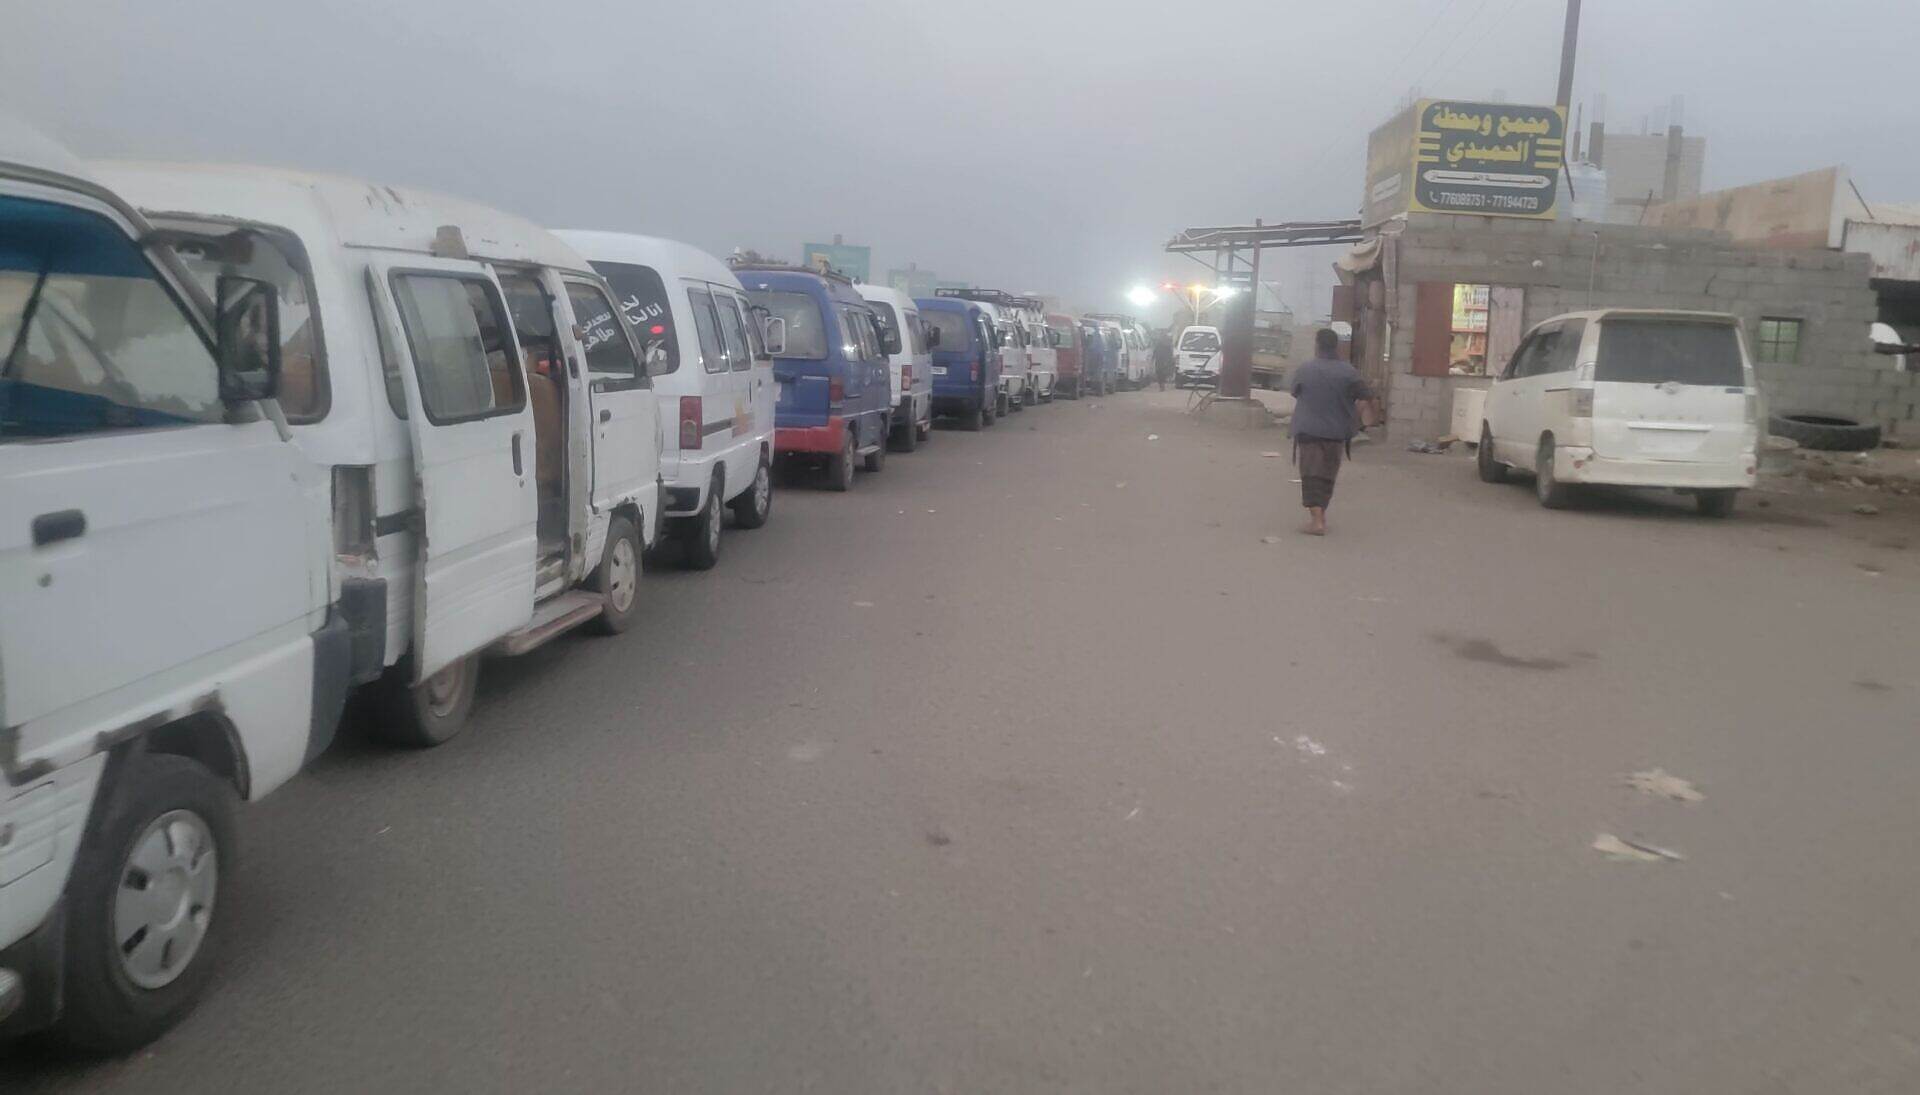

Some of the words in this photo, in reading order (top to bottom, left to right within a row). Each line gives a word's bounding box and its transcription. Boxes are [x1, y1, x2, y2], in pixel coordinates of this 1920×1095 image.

[1433, 105, 1492, 136] ومحطة
[1497, 116, 1550, 138] مجمع
[1447, 140, 1529, 168] الحميدي
